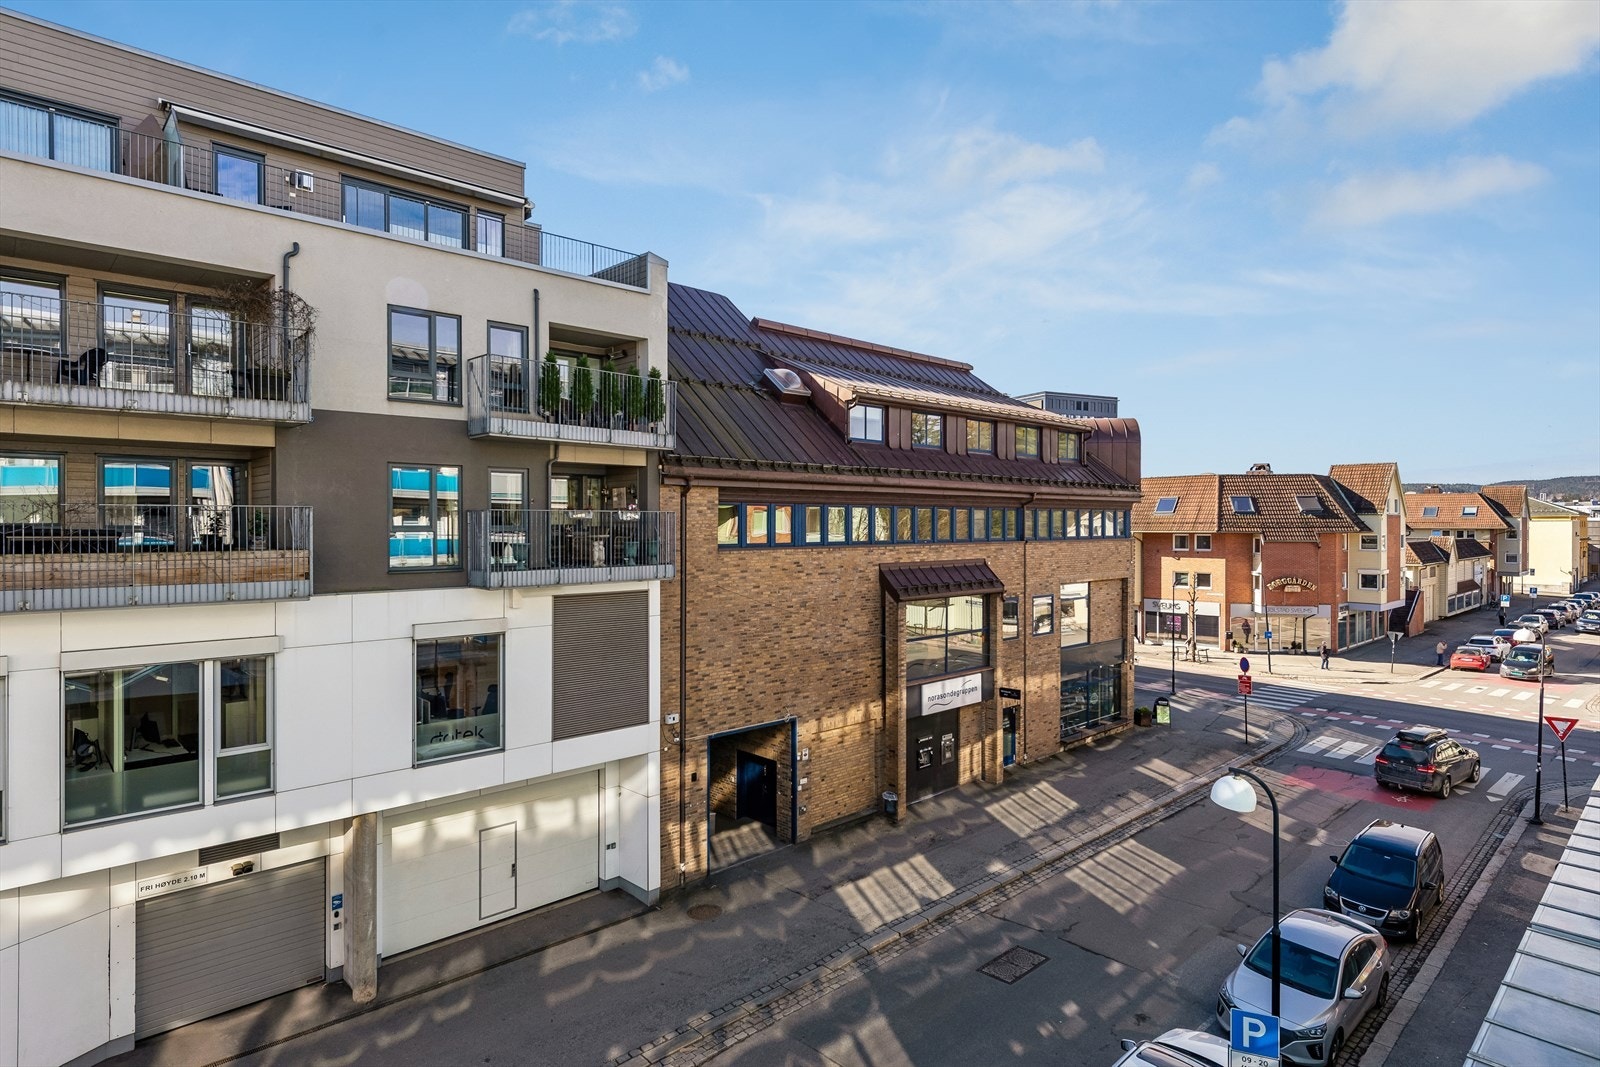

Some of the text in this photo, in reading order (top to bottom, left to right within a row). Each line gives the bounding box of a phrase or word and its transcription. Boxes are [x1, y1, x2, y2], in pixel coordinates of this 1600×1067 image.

[927, 686, 978, 702] norasondegruppen
[155, 878, 182, 888] HØYDE
[183, 874, 198, 882] 2.10
[1242, 1016, 1267, 1048] P
[1241, 1055, 1252, 1063] 09
[1258, 1059, 1269, 1067] 20
